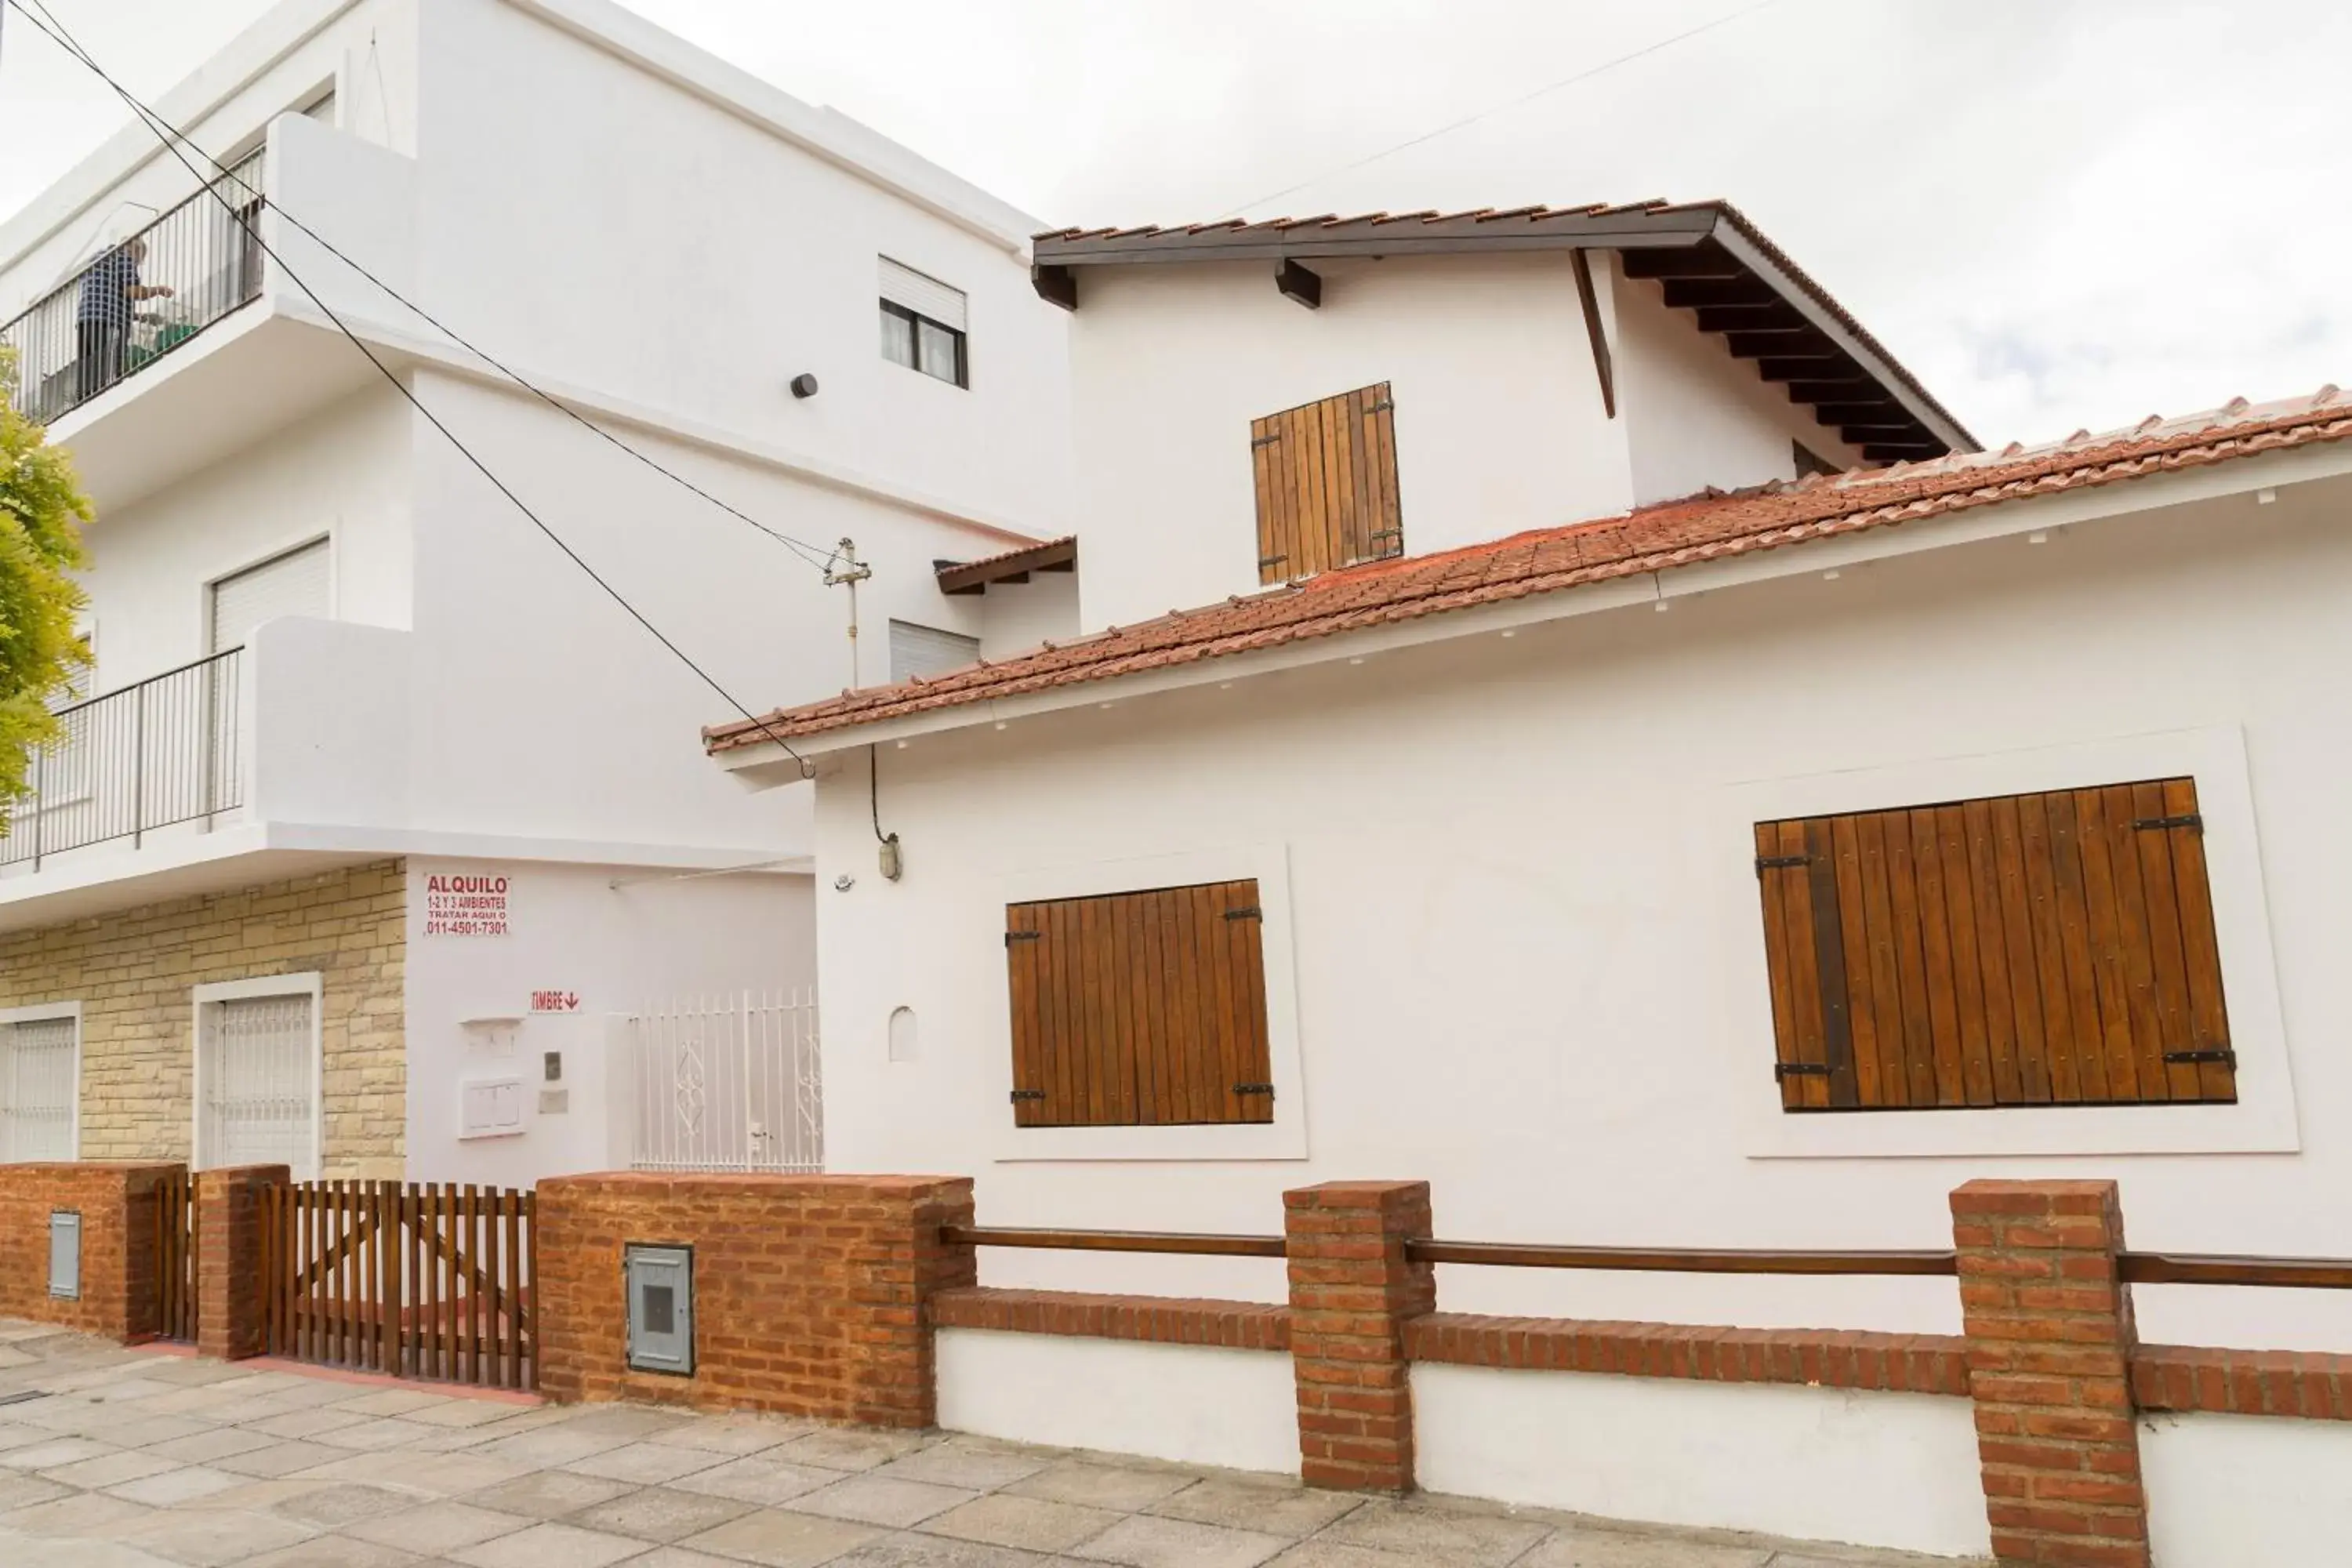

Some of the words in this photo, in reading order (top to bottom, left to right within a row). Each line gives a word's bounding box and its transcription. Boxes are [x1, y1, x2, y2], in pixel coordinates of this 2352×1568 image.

[427, 876, 507, 893] ALQUILO
[428, 896, 440, 909] 1-2
[443, 897, 449, 909] Y
[451, 897, 456, 909] 3
[459, 897, 506, 909] AMBIENTES
[427, 921, 507, 935] 011-4501-7301
[532, 991, 564, 1011] TIMBRE
